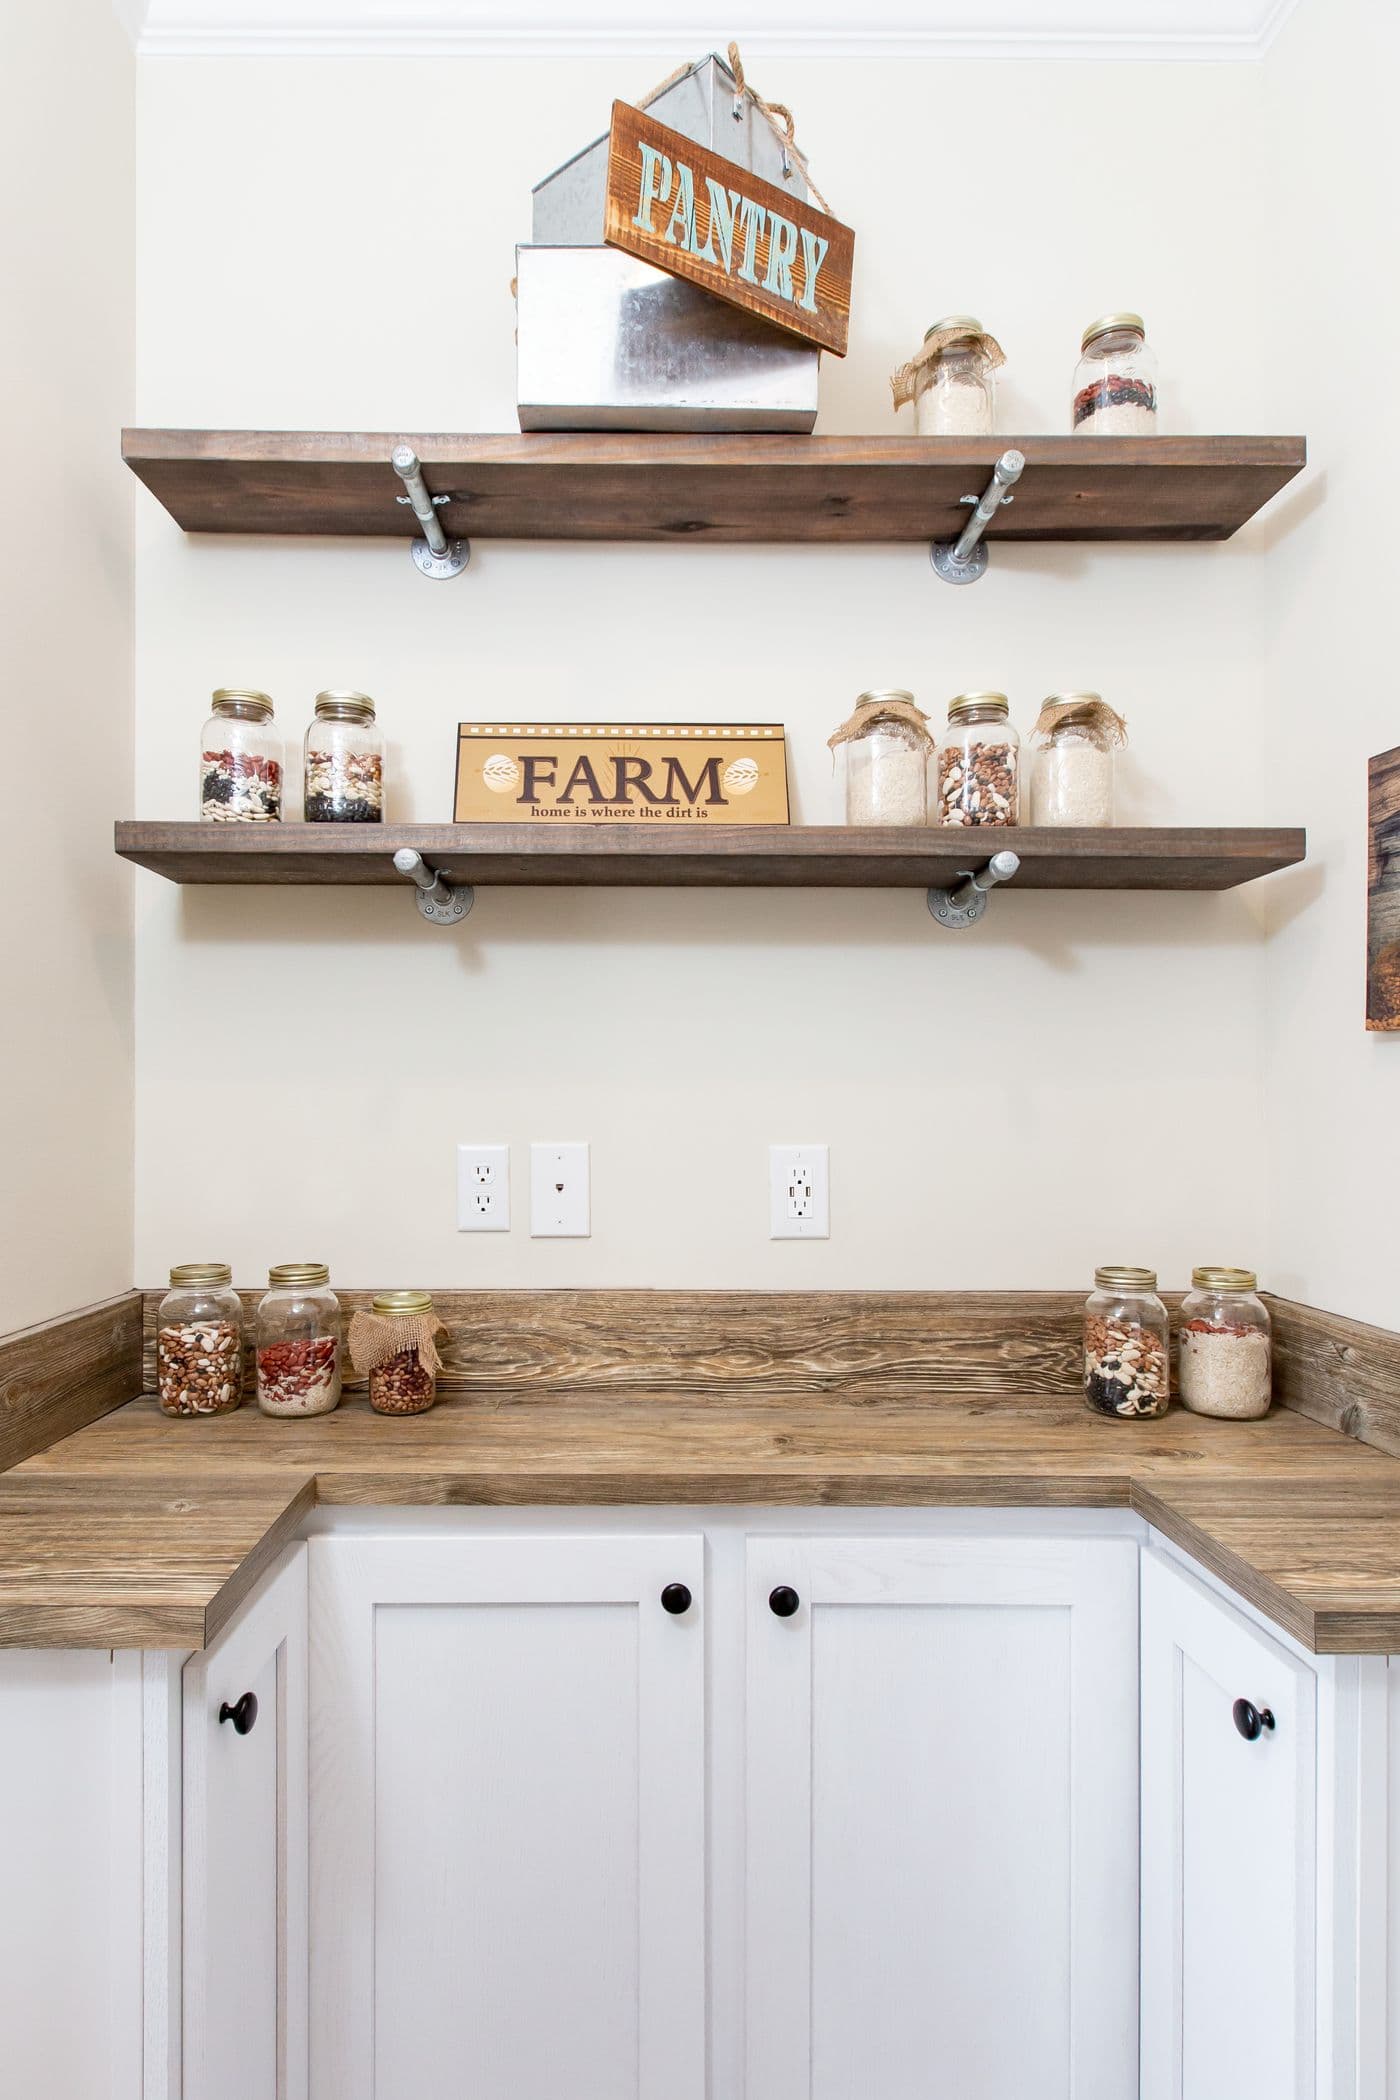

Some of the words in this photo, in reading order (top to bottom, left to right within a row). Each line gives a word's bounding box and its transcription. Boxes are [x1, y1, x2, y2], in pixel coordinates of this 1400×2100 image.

[632, 140, 829, 314] PANTRY
[516, 755, 729, 805] FARM
[531, 805, 571, 817] home
[575, 806, 587, 817] is
[591, 806, 635, 817] where
[640, 806, 662, 818] the
[666, 807, 692, 818] dirt
[696, 807, 708, 818] is
